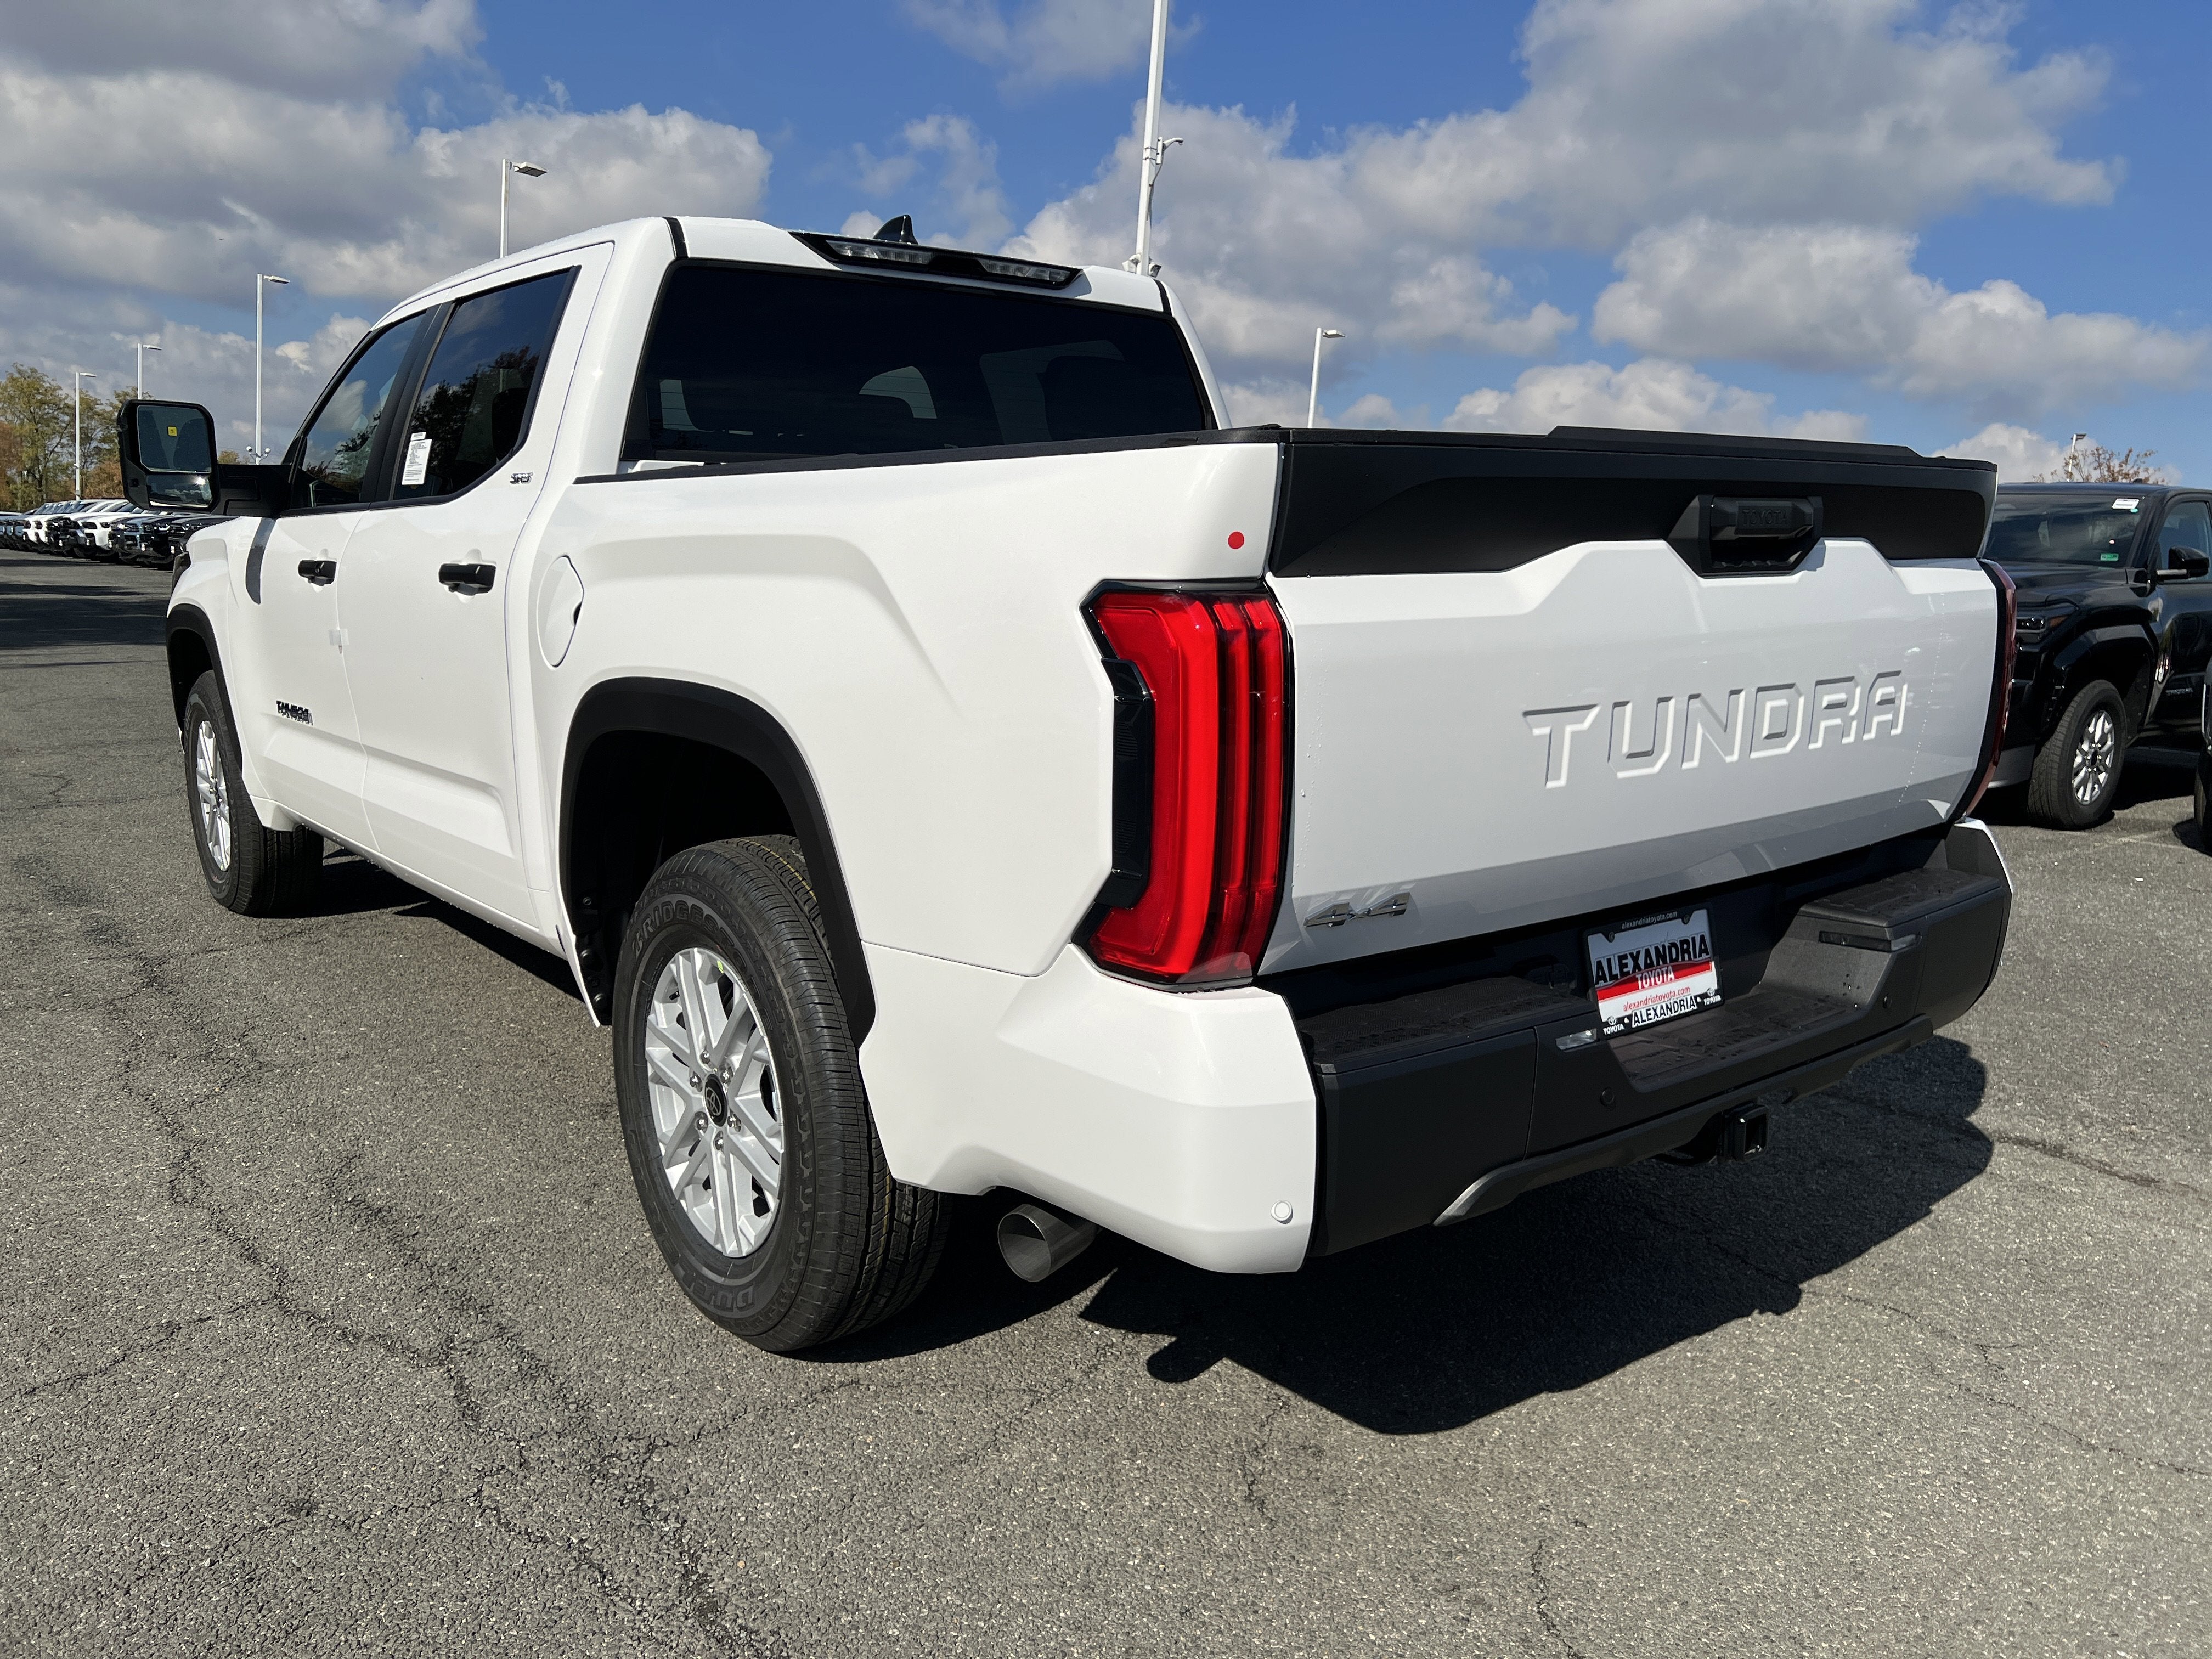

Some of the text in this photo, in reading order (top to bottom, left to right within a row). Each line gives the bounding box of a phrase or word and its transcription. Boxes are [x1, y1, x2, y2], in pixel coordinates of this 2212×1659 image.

[1742, 509, 1787, 526] TOYOTA
[1522, 670, 1908, 789] TUNDRA
[1622, 911, 1678, 930] alexandriatoyota.com
[631, 900, 774, 1031] BRIDGESTONE
[1594, 934, 1710, 985] ALEXANDRIA
[1636, 965, 1675, 990] TOYOTA
[1623, 986, 1690, 1012] alexandriatoyota.com
[1633, 996, 1697, 1027] ALEXANDRIA
[1703, 995, 1721, 1006] TOYOTA
[1602, 1023, 1624, 1035] TOYOTA
